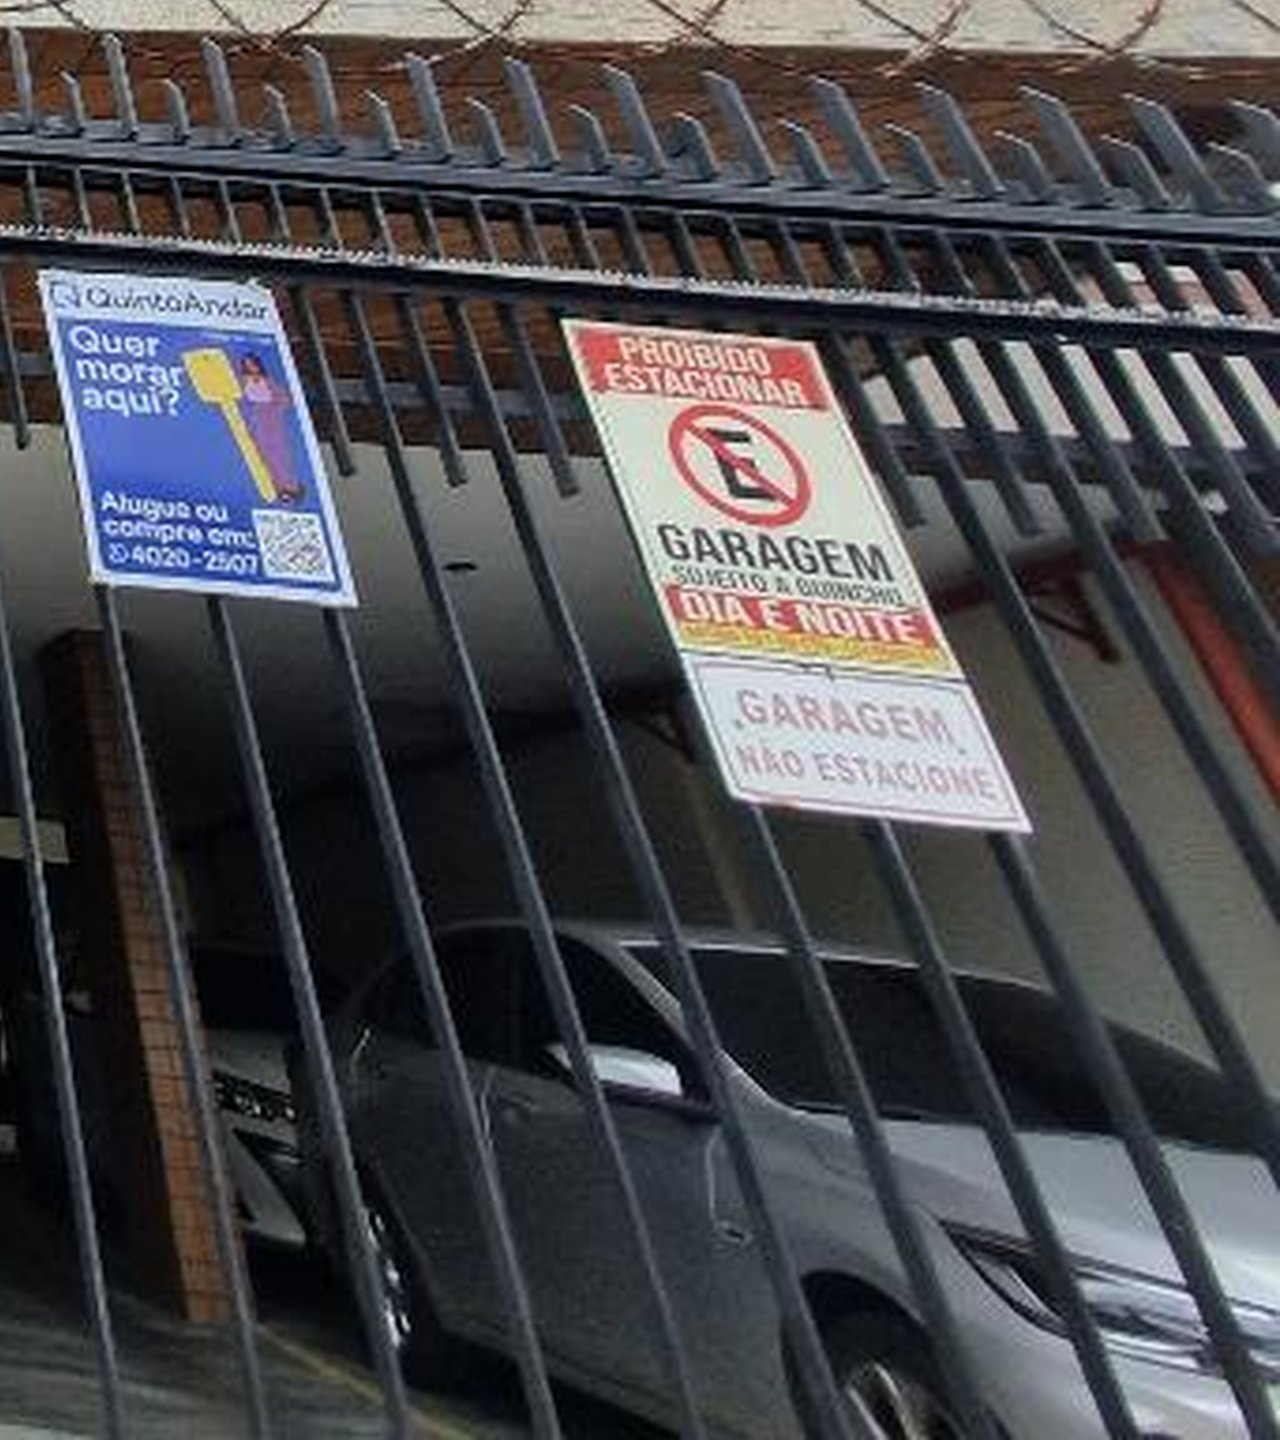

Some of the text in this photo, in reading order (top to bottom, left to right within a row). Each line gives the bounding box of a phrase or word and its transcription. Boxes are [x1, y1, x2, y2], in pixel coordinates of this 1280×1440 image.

[86, 286, 267, 320] QuintoAndar
[70, 326, 160, 357] Quer
[618, 336, 772, 376] PROIBIDO
[76, 358, 183, 387] morar
[604, 363, 809, 406] ESTACIONAR
[83, 387, 179, 418] aqui?
[101, 491, 230, 523] Alugue ou
[103, 519, 203, 544] compre
[658, 523, 895, 582] GARAGEM
[680, 592, 756, 627] DIA
[761, 601, 791, 633] E
[795, 605, 933, 646] NOITE
[738, 688, 955, 746] GARAGEM
[812, 750, 998, 800] ESTACIONE
